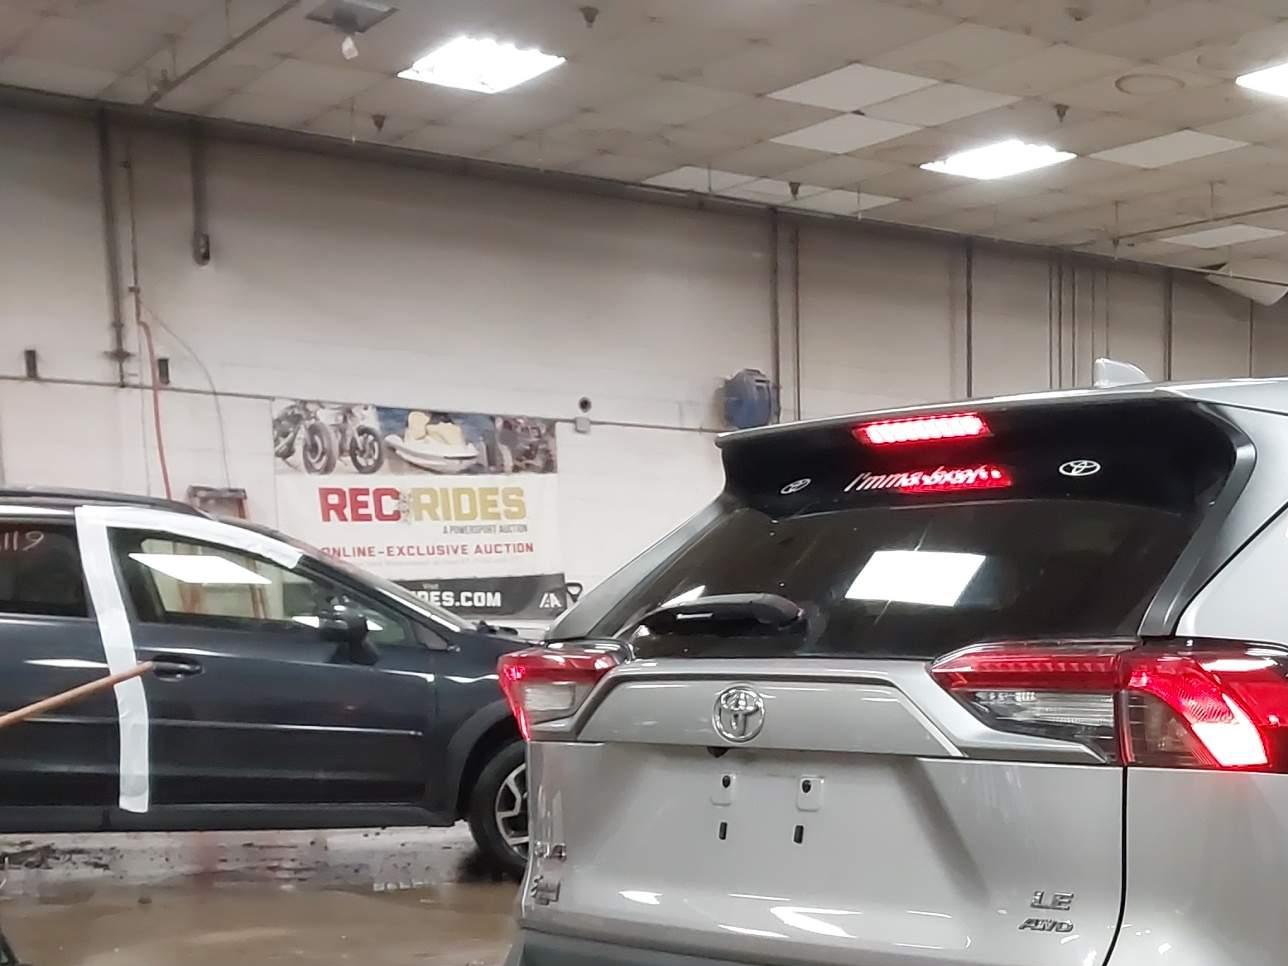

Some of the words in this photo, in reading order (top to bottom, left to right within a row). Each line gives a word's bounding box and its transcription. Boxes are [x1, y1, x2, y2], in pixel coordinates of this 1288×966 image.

[318, 487, 401, 522] REC
[410, 487, 527, 522] RIDES
[0, 530, 45, 551] 119
[473, 543, 534, 555] AUCTION
[1030, 891, 1075, 911] LE
[1018, 918, 1074, 933] AWD
